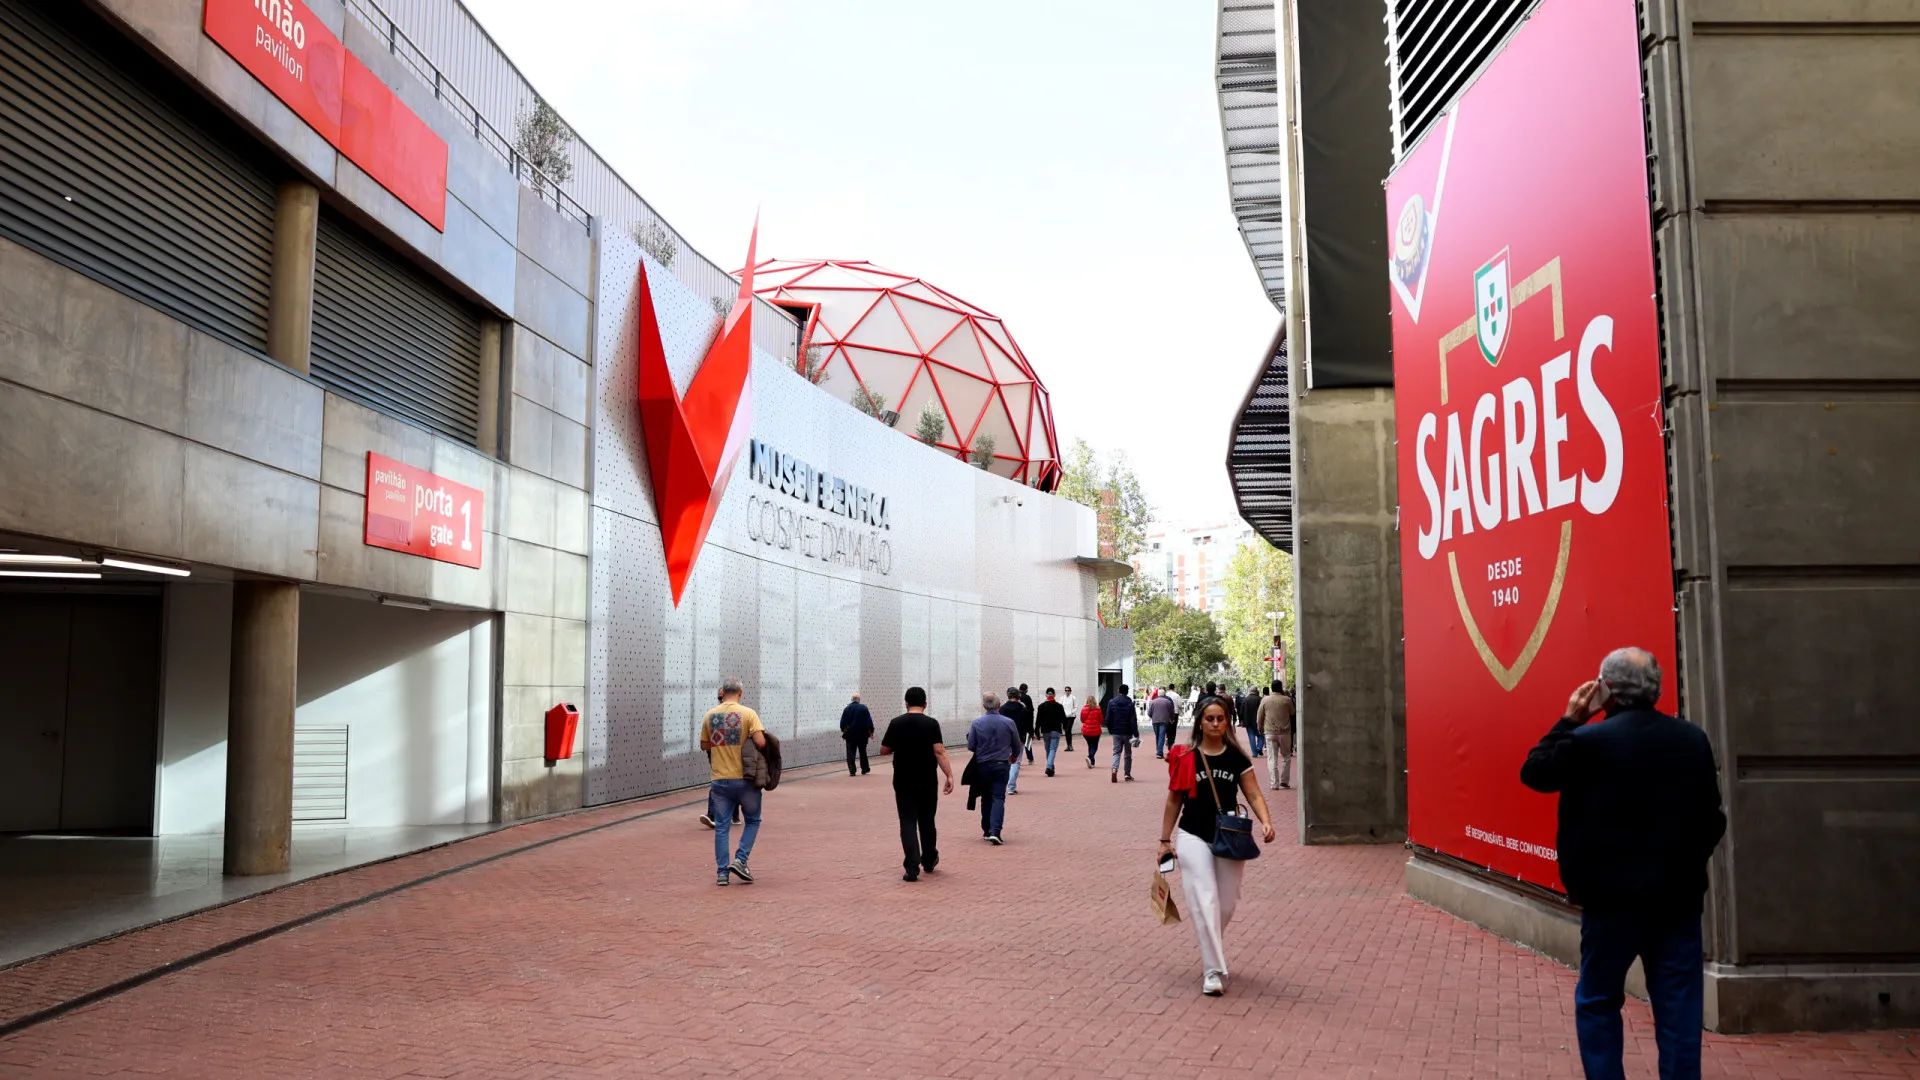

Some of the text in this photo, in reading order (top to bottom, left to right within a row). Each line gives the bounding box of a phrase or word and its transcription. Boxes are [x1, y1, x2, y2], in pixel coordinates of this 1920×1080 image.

[255, 24, 303, 82] pavilion
[1416, 314, 1624, 560] SAGRES
[375, 470, 406, 489] pavilhão
[750, 438, 890, 531] MUSEU BENFICA
[415, 484, 472, 552] porta 1
[430, 524, 454, 547] gate
[747, 495, 891, 576] COSME DAMIÃO
[1487, 557, 1522, 581] DESDE
[1492, 586, 1519, 607] 1940
[1196, 769, 1234, 782] BEFICA
[1505, 837, 1519, 851] BEBE
[1519, 841, 1533, 855] COM
[1533, 844, 1558, 861] MODERA
